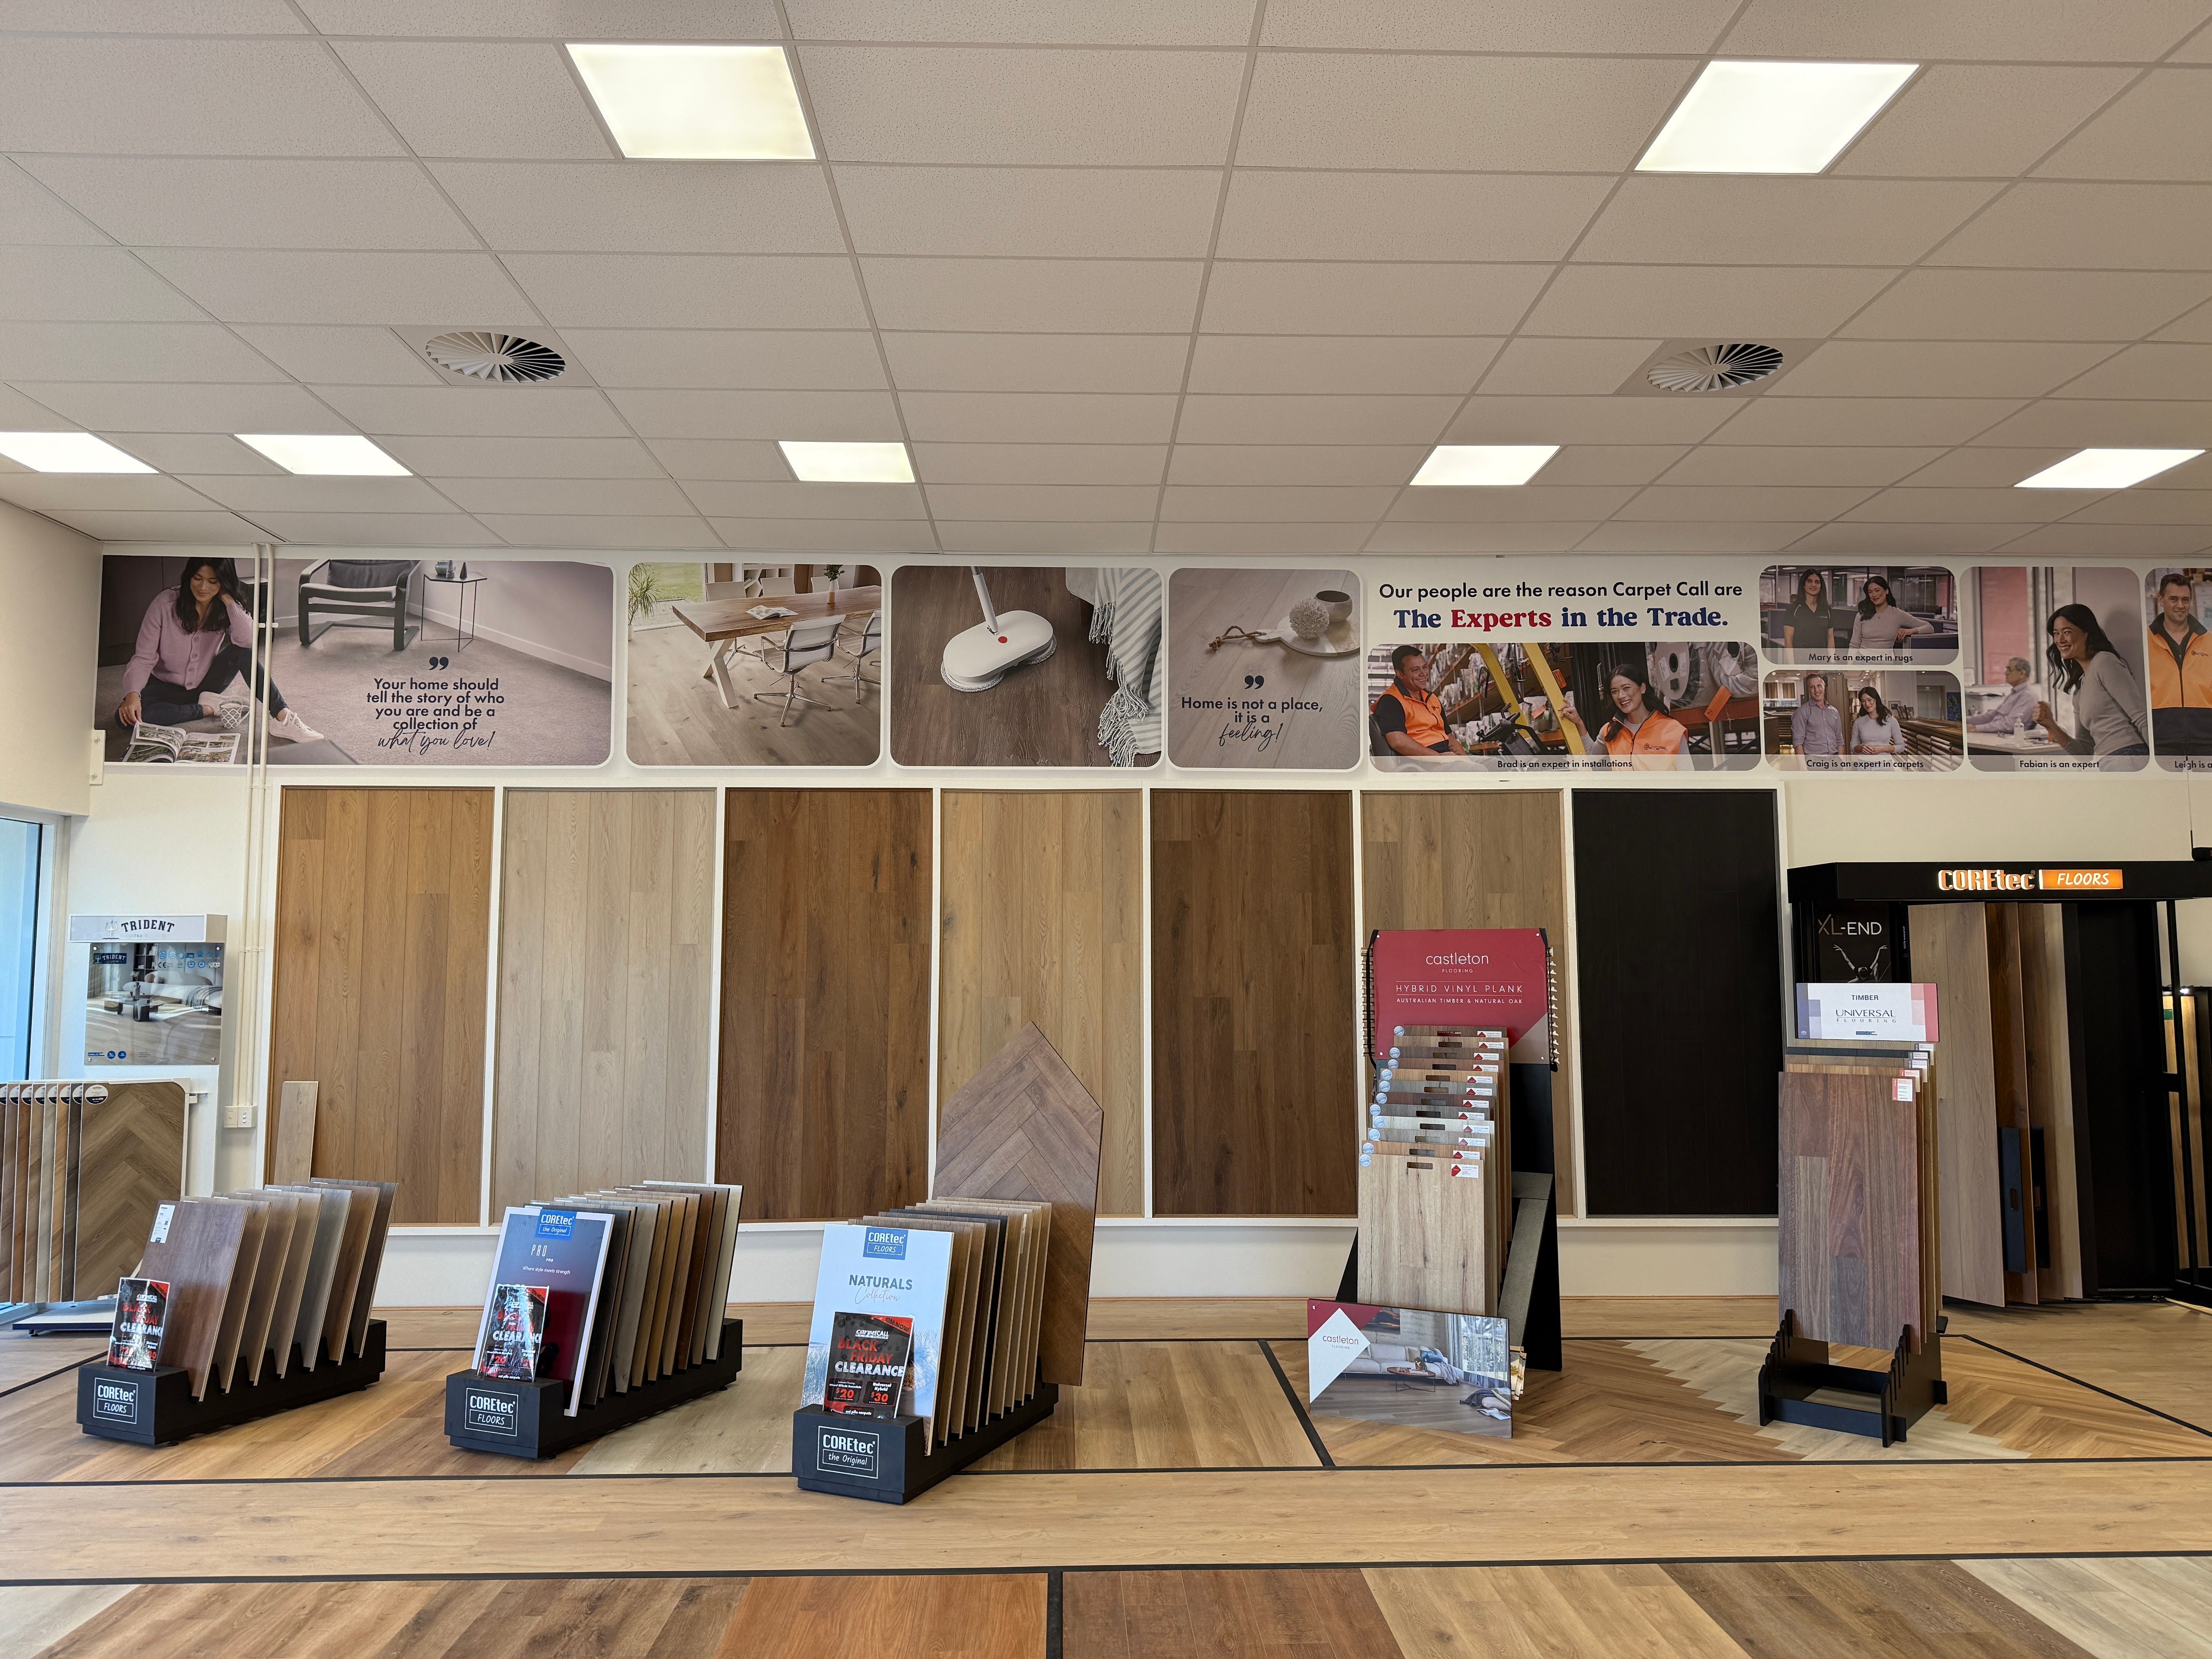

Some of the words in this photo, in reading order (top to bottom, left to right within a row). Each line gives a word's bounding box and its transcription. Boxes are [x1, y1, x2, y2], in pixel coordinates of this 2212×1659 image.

[1379, 584, 1412, 598] Our
[1418, 582, 1477, 602] people
[1483, 586, 1511, 598] are
[1516, 582, 1543, 597] the
[1548, 584, 1607, 597] reason
[1613, 582, 1671, 600] Carpet
[1676, 580, 1709, 596] Call
[1714, 584, 1742, 596] are
[1394, 609, 1441, 629] The
[1451, 609, 1552, 632] Experts
[1561, 607, 1587, 628] in
[1597, 607, 1637, 627] the
[1647, 607, 1728, 627] Trade.
[1808, 653, 1831, 663] Mary
[1855, 654, 1882, 663] expert
[374, 678, 406, 690] Your
[410, 677, 448, 690] home
[453, 678, 499, 690] should
[367, 690, 387, 703] tell
[392, 690, 412, 703] the
[417, 693, 452, 706] story
[457, 691, 471, 704] of
[474, 692, 504, 703] who
[375, 708, 401, 719] you
[406, 708, 429, 716] are
[433, 704, 460, 716] and
[465, 704, 482, 716] be
[486, 708, 495, 716] a
[1182, 697, 1223, 709] Home
[1227, 697, 1237, 709] is
[1242, 699, 1264, 709] not
[1268, 701, 1276, 709] a
[1281, 697, 1322, 713] place,
[393, 717, 458, 730] collection
[463, 718, 477, 730] of
[1235, 711, 1242, 723] it
[1247, 711, 1257, 723] is
[1261, 714, 1269, 723] a
[378, 728, 426, 752] what
[420, 732, 449, 755] you
[454, 729, 495, 750] love!
[1218, 721, 1283, 752] feeling!
[1542, 761, 1570, 769] expert
[1806, 759, 1829, 768] Craig
[1893, 761, 1923, 769] carpets
[2072, 761, 2099, 769] expert
[2175, 760, 2196, 770] Leigh
[2057, 872, 2109, 885] FLOORS
[121, 919, 175, 932] TRIDENT
[1818, 914, 1882, 935] XL-END
[1426, 952, 1489, 965] castleton
[531, 1244, 547, 1257] PRO
[849, 1274, 912, 1290] NATURALS
[855, 1284, 900, 1304] Collection
[122, 1302, 151, 1314] BLAK
[132, 1314, 159, 1325] FDAY
[120, 1322, 163, 1336] CLEARANC
[837, 1338, 879, 1352] BLACK
[1322, 1335, 1358, 1345] castleton
[850, 1350, 894, 1364] FRIDAY
[835, 1361, 905, 1377] CLEARANCE
[835, 1388, 855, 1399] $20
[871, 1391, 889, 1402] $30
[104, 1402, 127, 1413] FLOORS
[477, 1413, 505, 1425] FLOORS
[828, 1452, 840, 1461] the
[842, 1455, 867, 1466] Original
